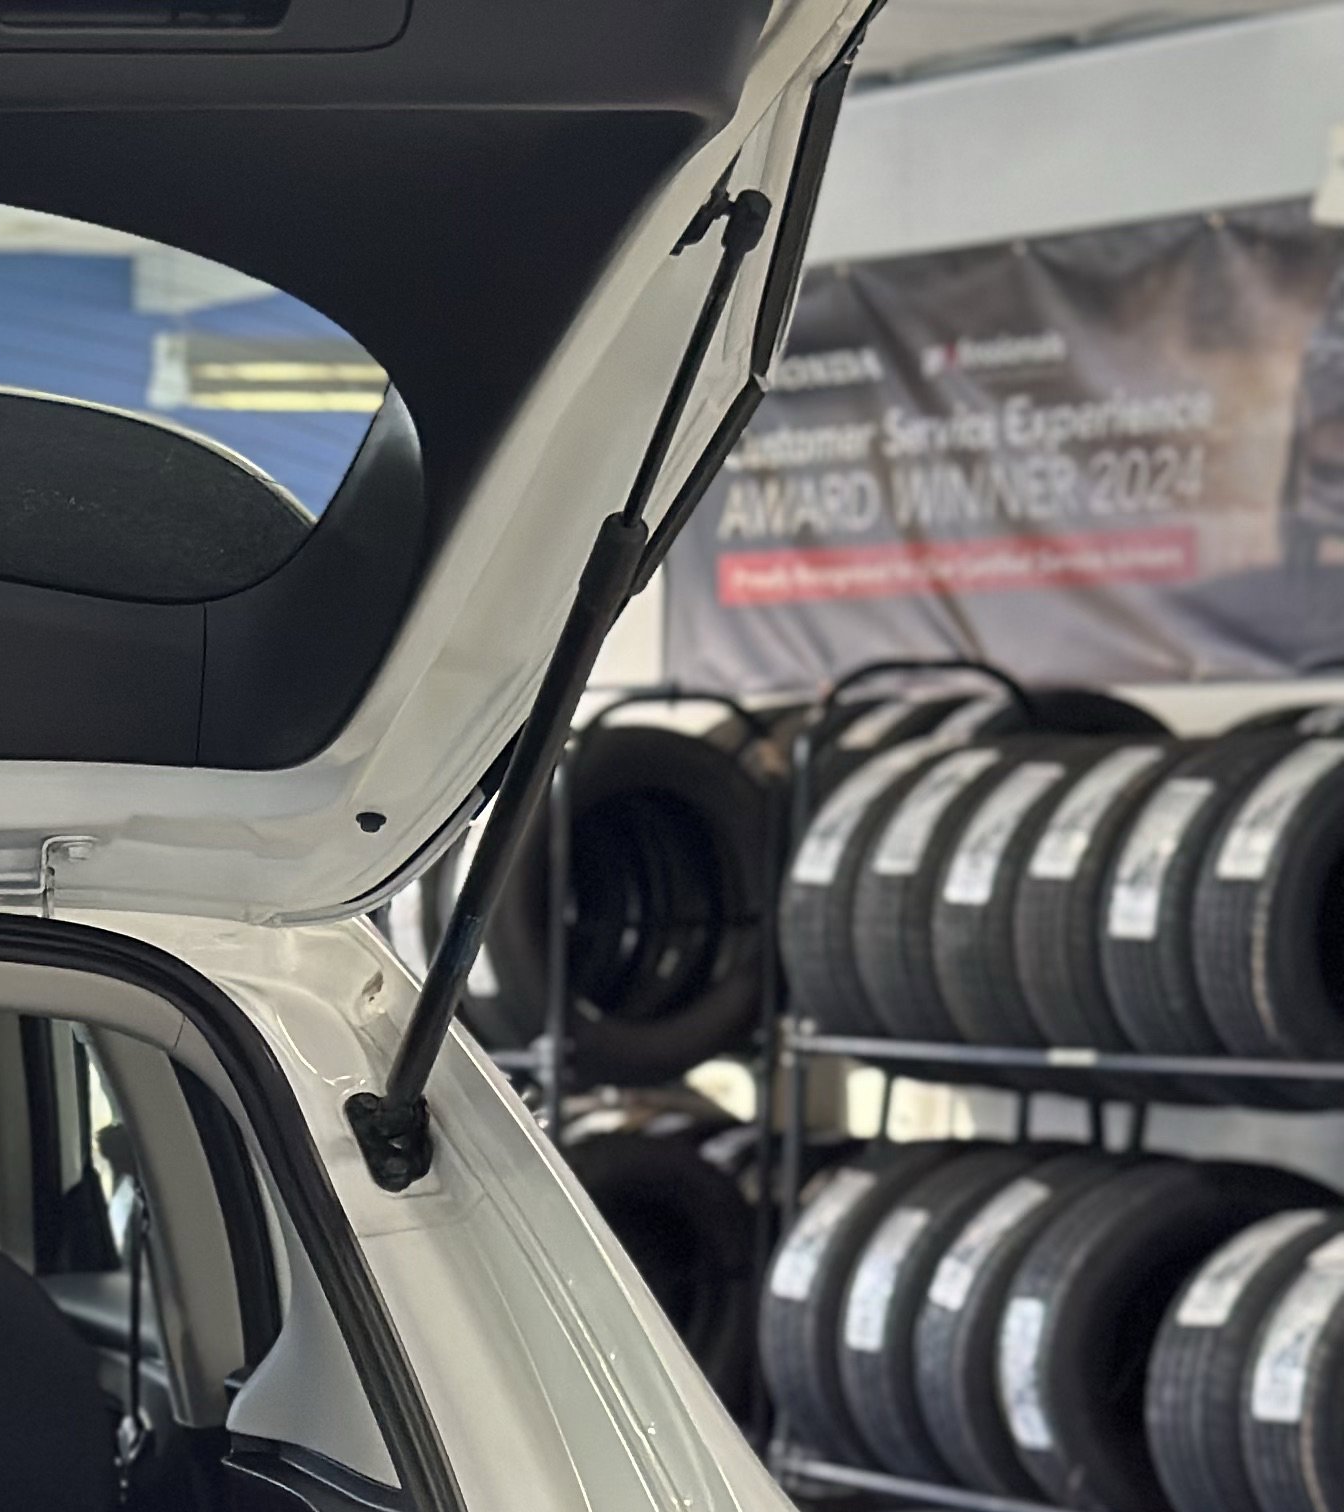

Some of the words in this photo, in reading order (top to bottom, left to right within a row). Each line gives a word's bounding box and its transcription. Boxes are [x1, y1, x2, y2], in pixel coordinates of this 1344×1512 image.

[716, 470, 882, 541] AWARD
[891, 454, 1078, 528] WINNER
[1087, 444, 1205, 514] 2024
